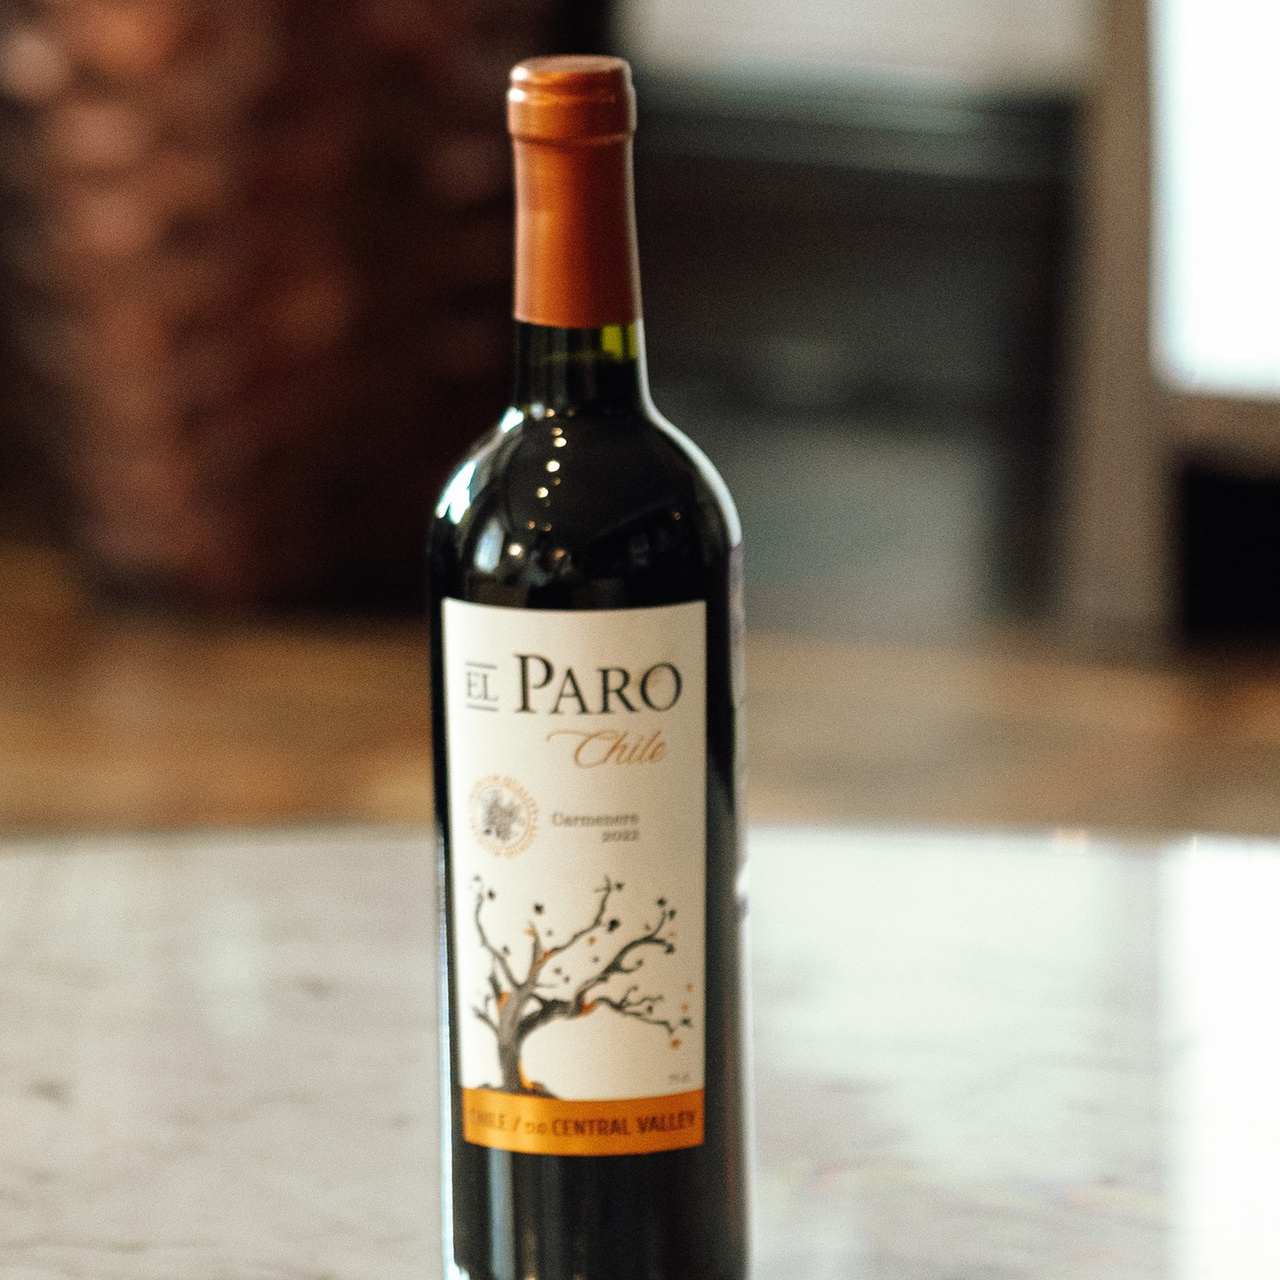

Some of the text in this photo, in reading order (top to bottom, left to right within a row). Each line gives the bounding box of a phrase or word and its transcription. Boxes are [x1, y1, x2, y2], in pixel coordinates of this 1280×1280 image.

[465, 652, 683, 715] EL PARO
[545, 728, 666, 769] Chile
[551, 1116, 630, 1137] CENTRAL
[636, 1108, 696, 1133] VALLEY
